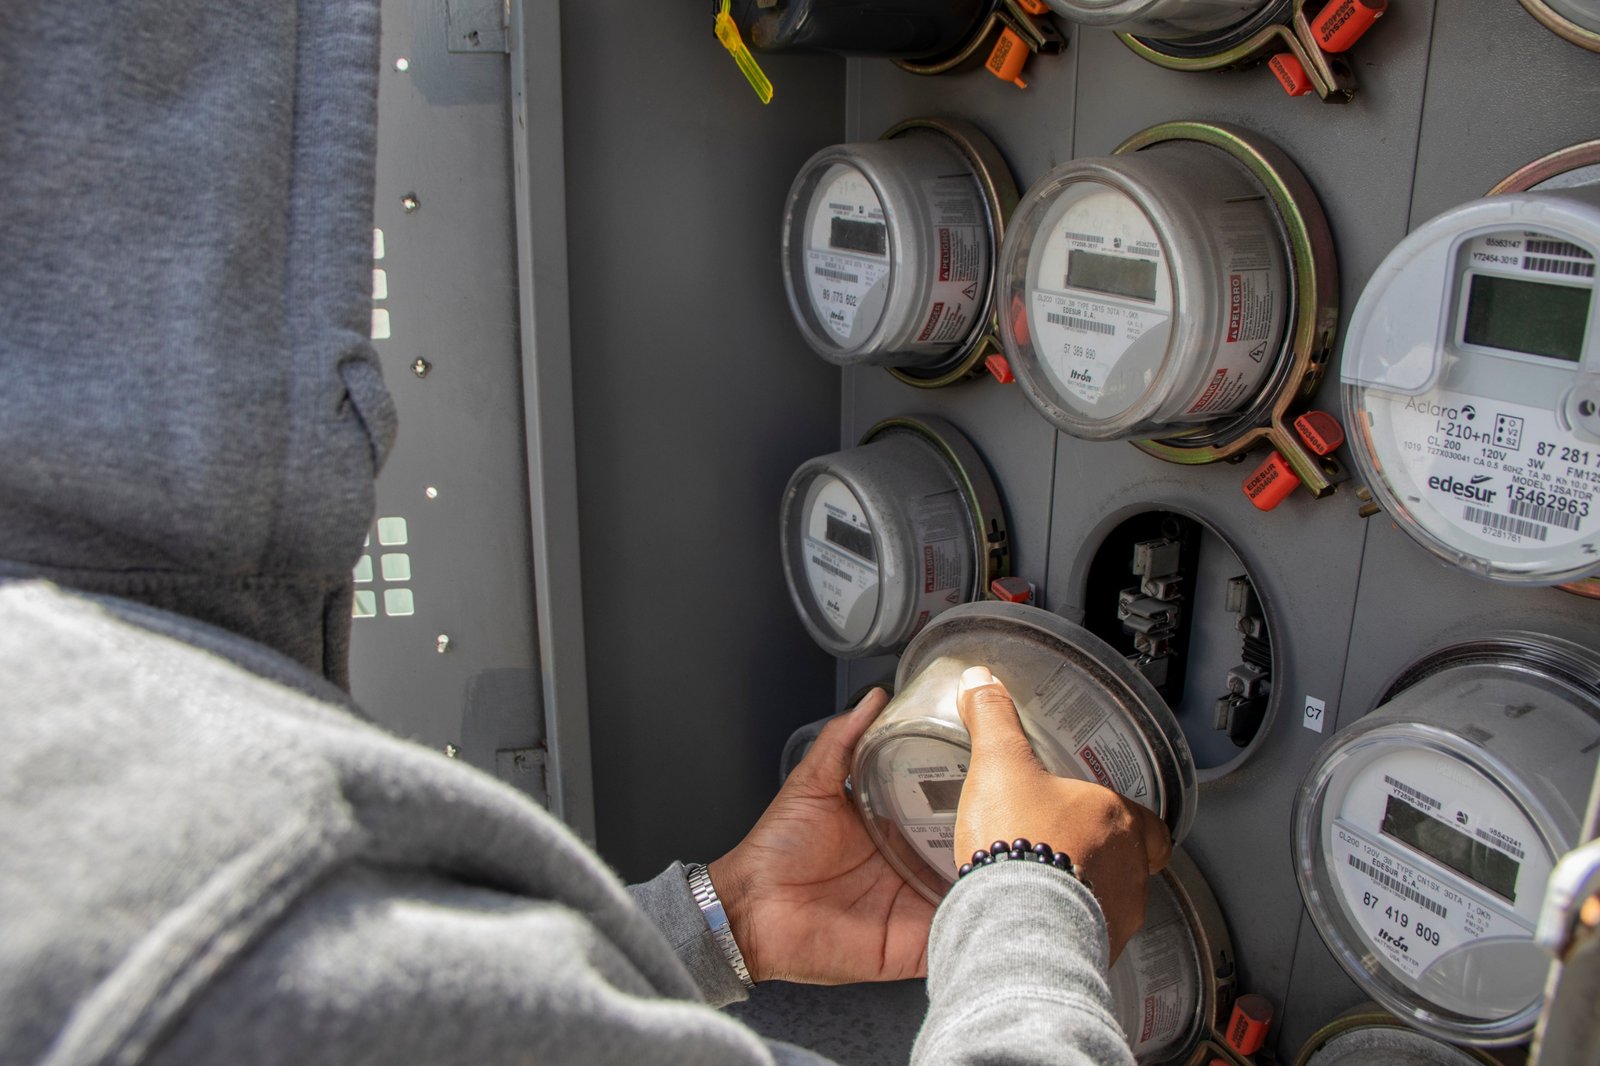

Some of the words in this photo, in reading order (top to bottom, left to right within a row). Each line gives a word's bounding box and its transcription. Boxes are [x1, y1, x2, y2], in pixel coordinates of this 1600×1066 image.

[1322, 6, 1355, 42] EDESUR
[1062, 307, 1082, 315] EDESUR
[1231, 278, 1240, 328] PELIGRO
[1404, 396, 1458, 420] Aclara
[1505, 437, 1516, 446] S2
[1507, 428, 1518, 437] V2
[1427, 435, 1440, 447] CL
[1443, 439, 1461, 451] 200
[1482, 448, 1507, 461] 120V
[1527, 458, 1545, 470] 3W
[1536, 441, 1556, 457] 87
[1561, 446, 1590, 465] 281
[1246, 463, 1276, 491] EDESUR
[1473, 457, 1485, 466] CA
[1502, 464, 1524, 475] 60HZ
[1528, 470, 1539, 479] TA
[1541, 473, 1551, 482] 30
[1512, 475, 1545, 490] MODEL
[1428, 475, 1497, 503] edesur
[1506, 484, 1590, 517] 15462963
[1305, 705, 1321, 720] C7
[1339, 831, 1359, 847] CL200
[1364, 845, 1380, 858] 120V
[1396, 862, 1413, 877] TYPE
[1444, 889, 1463, 906] 30TA
[1372, 857, 1399, 877] EDESUR
[1402, 874, 1419, 890] S.A.
[1363, 891, 1379, 909] 87
[1385, 905, 1409, 927] 419
[1415, 922, 1440, 946] 809
